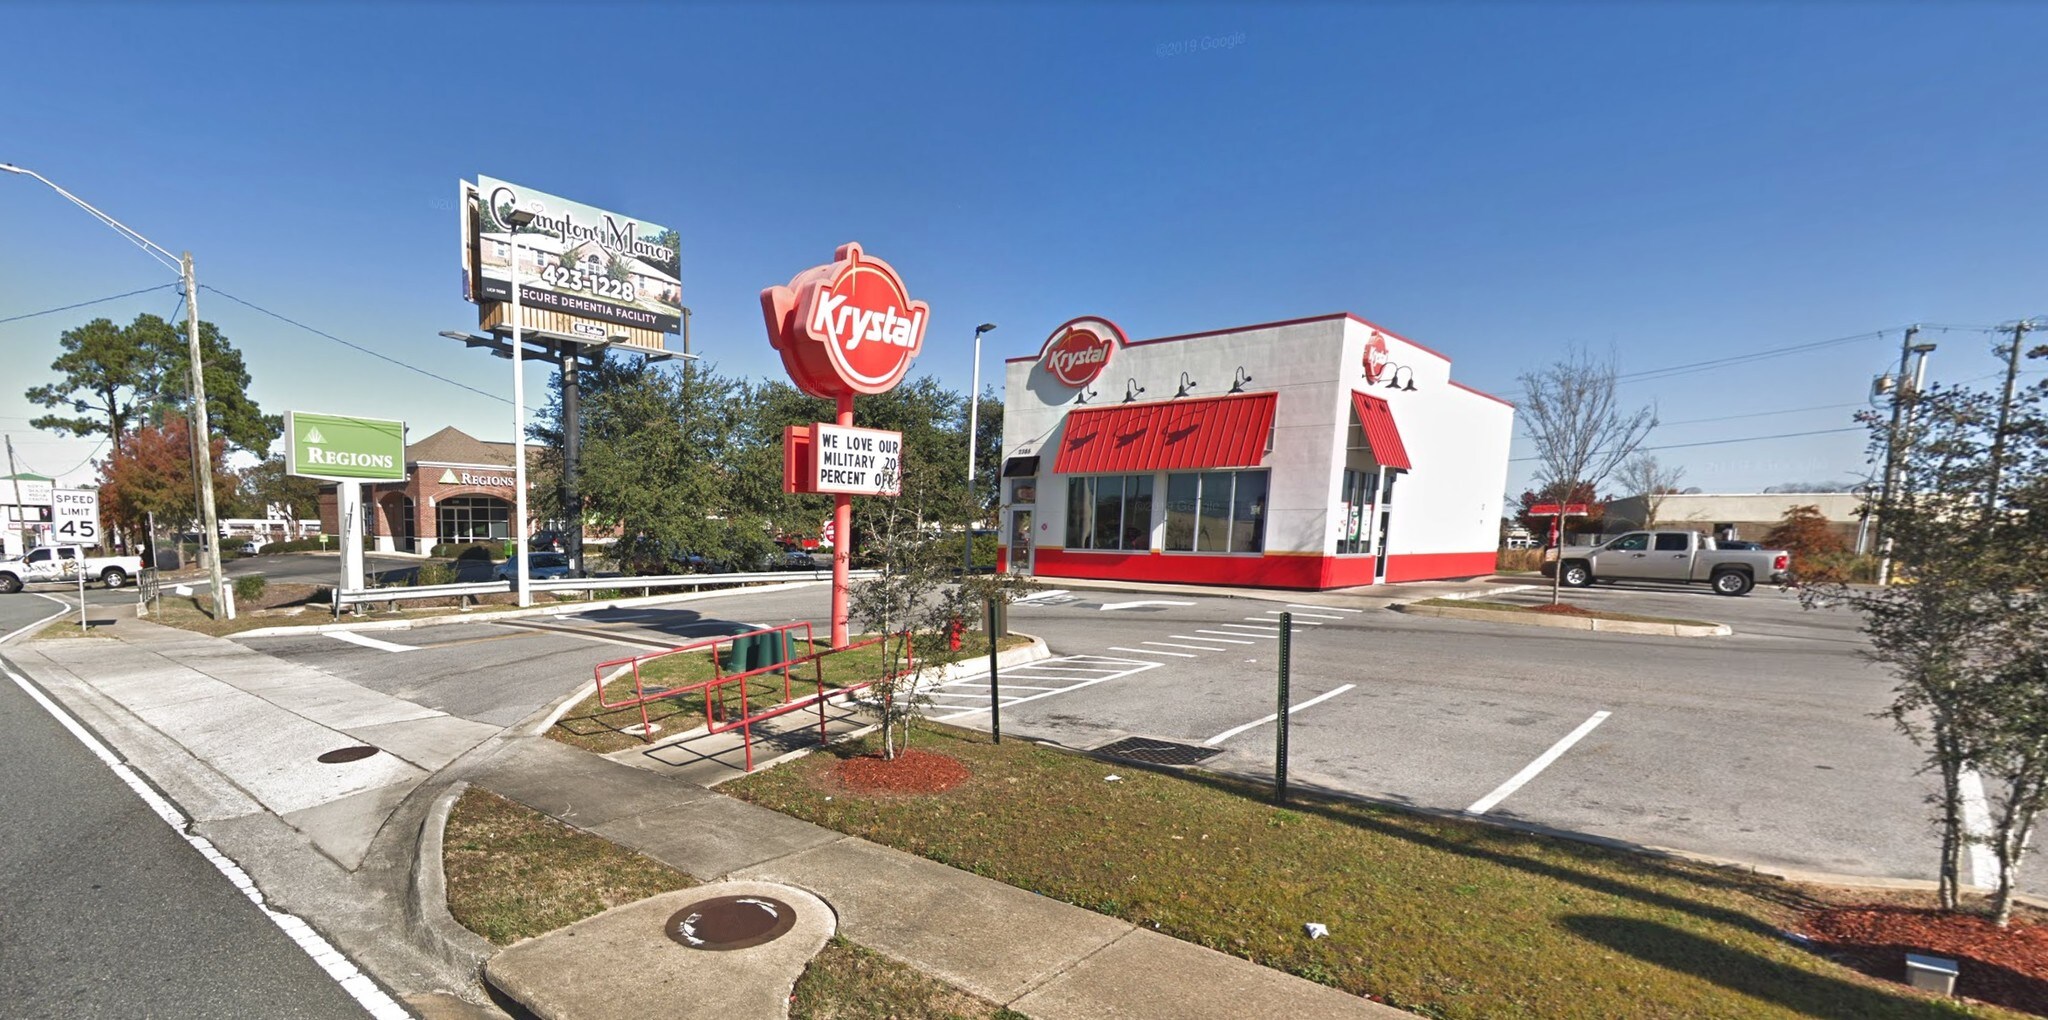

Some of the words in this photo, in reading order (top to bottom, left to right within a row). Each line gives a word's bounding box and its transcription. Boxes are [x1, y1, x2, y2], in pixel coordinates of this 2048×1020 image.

[603, 214, 672, 261] Manor
[542, 265, 634, 302] 423-1228
[518, 289, 558, 305] SECURE
[561, 297, 613, 316] DEMENTIA
[616, 309, 657, 323] FACILITY
[813, 290, 923, 351] Krystal
[1048, 343, 1109, 373] Krystal
[822, 433, 838, 449] WE
[846, 436, 873, 452] LOVE
[878, 439, 899, 454] OUR
[307, 446, 393, 469] REGIONS
[823, 451, 875, 469] MILITARY
[885, 457, 897, 471] 20
[461, 472, 514, 487] REGIONS
[820, 468, 866, 486] PERCENT
[56, 494, 94, 504] SPEED
[61, 508, 90, 516] LIMIT
[59, 520, 94, 537] 45
